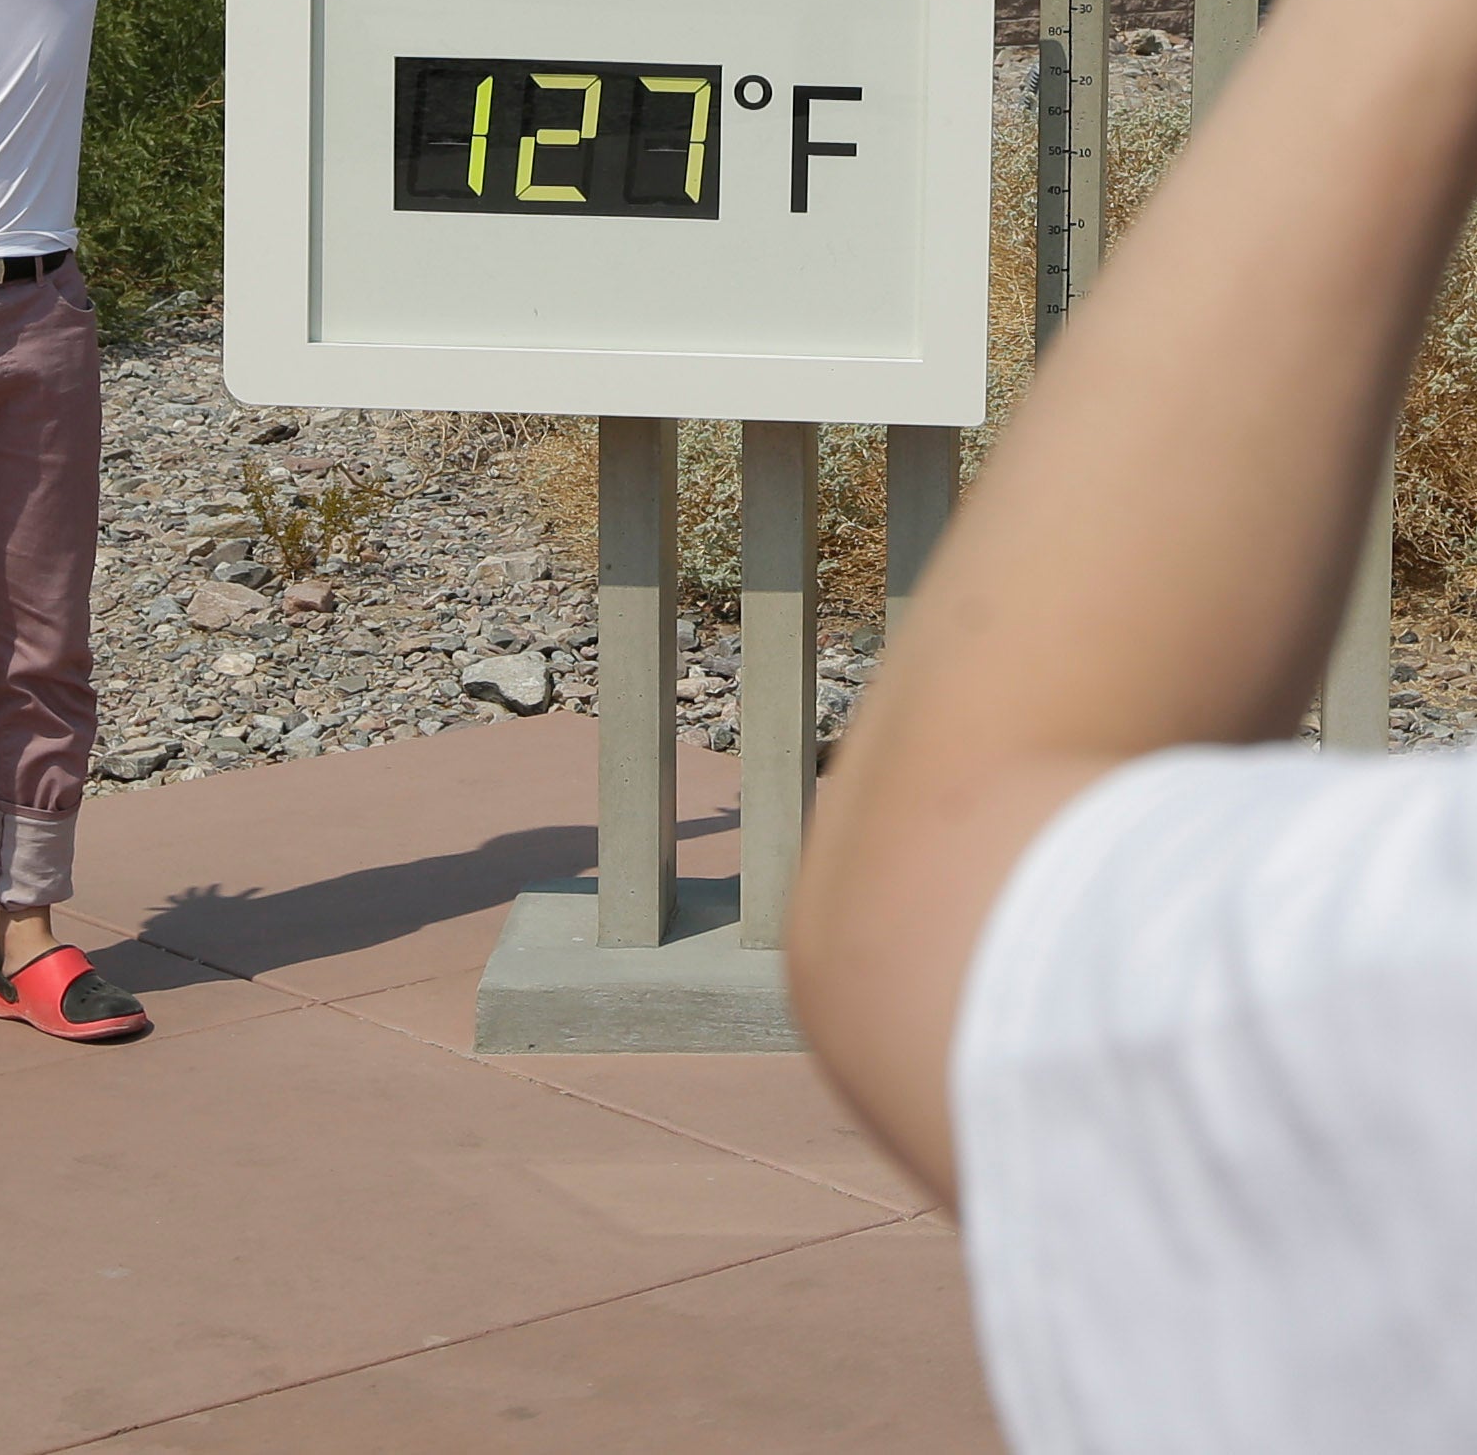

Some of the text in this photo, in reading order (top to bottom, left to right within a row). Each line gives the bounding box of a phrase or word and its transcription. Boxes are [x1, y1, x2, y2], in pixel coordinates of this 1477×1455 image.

[1080, 4, 1093, 14] 30
[1048, 27, 1062, 36] 80
[1050, 66, 1062, 76] 70
[1079, 76, 1093, 86] 20
[1048, 106, 1062, 116] 60
[1048, 146, 1062, 156] 50
[1079, 148, 1092, 158] 10
[1047, 186, 1061, 196] 40
[1078, 219, 1085, 229] 0
[1048, 225, 1061, 235] 30
[1047, 265, 1060, 275] 20
[1046, 305, 1059, 314] 10
